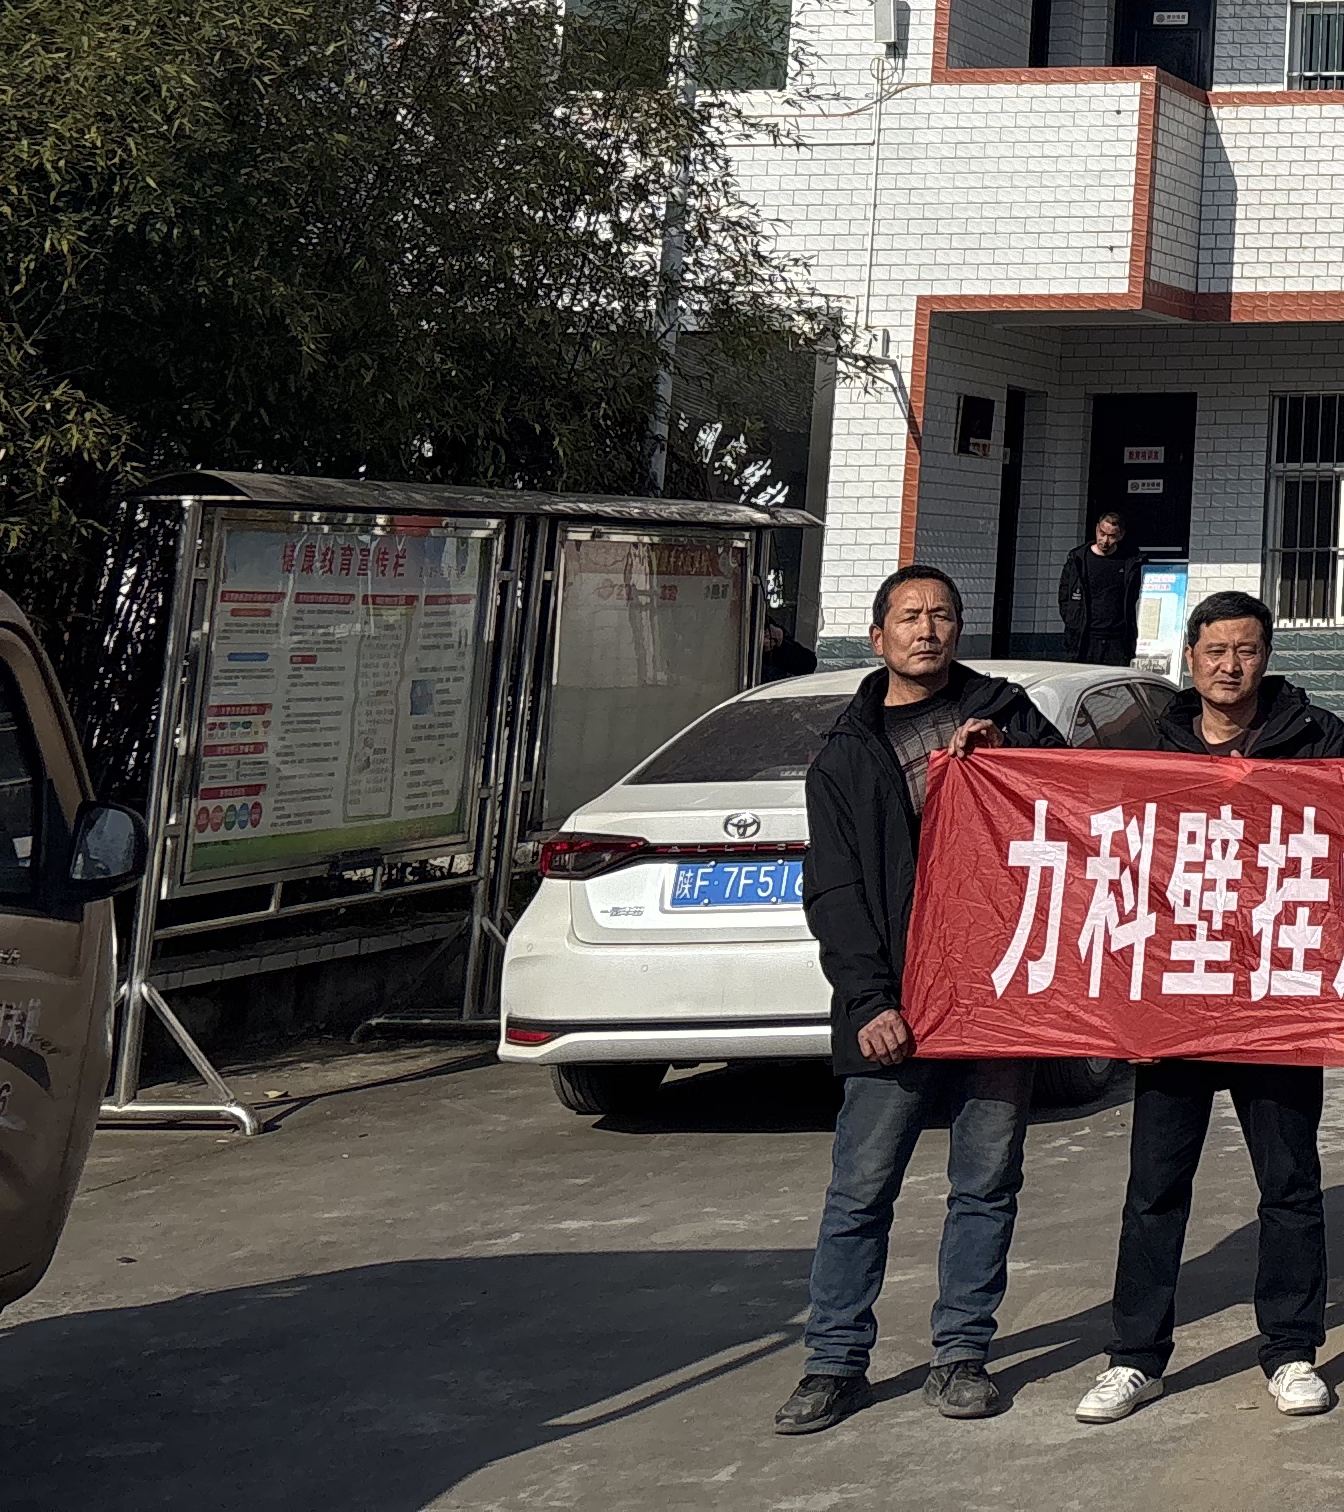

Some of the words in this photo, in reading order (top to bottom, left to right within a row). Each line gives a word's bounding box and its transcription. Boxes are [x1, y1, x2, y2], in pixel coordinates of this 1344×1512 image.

[281, 541, 407, 578] 健康教育宣传栏
